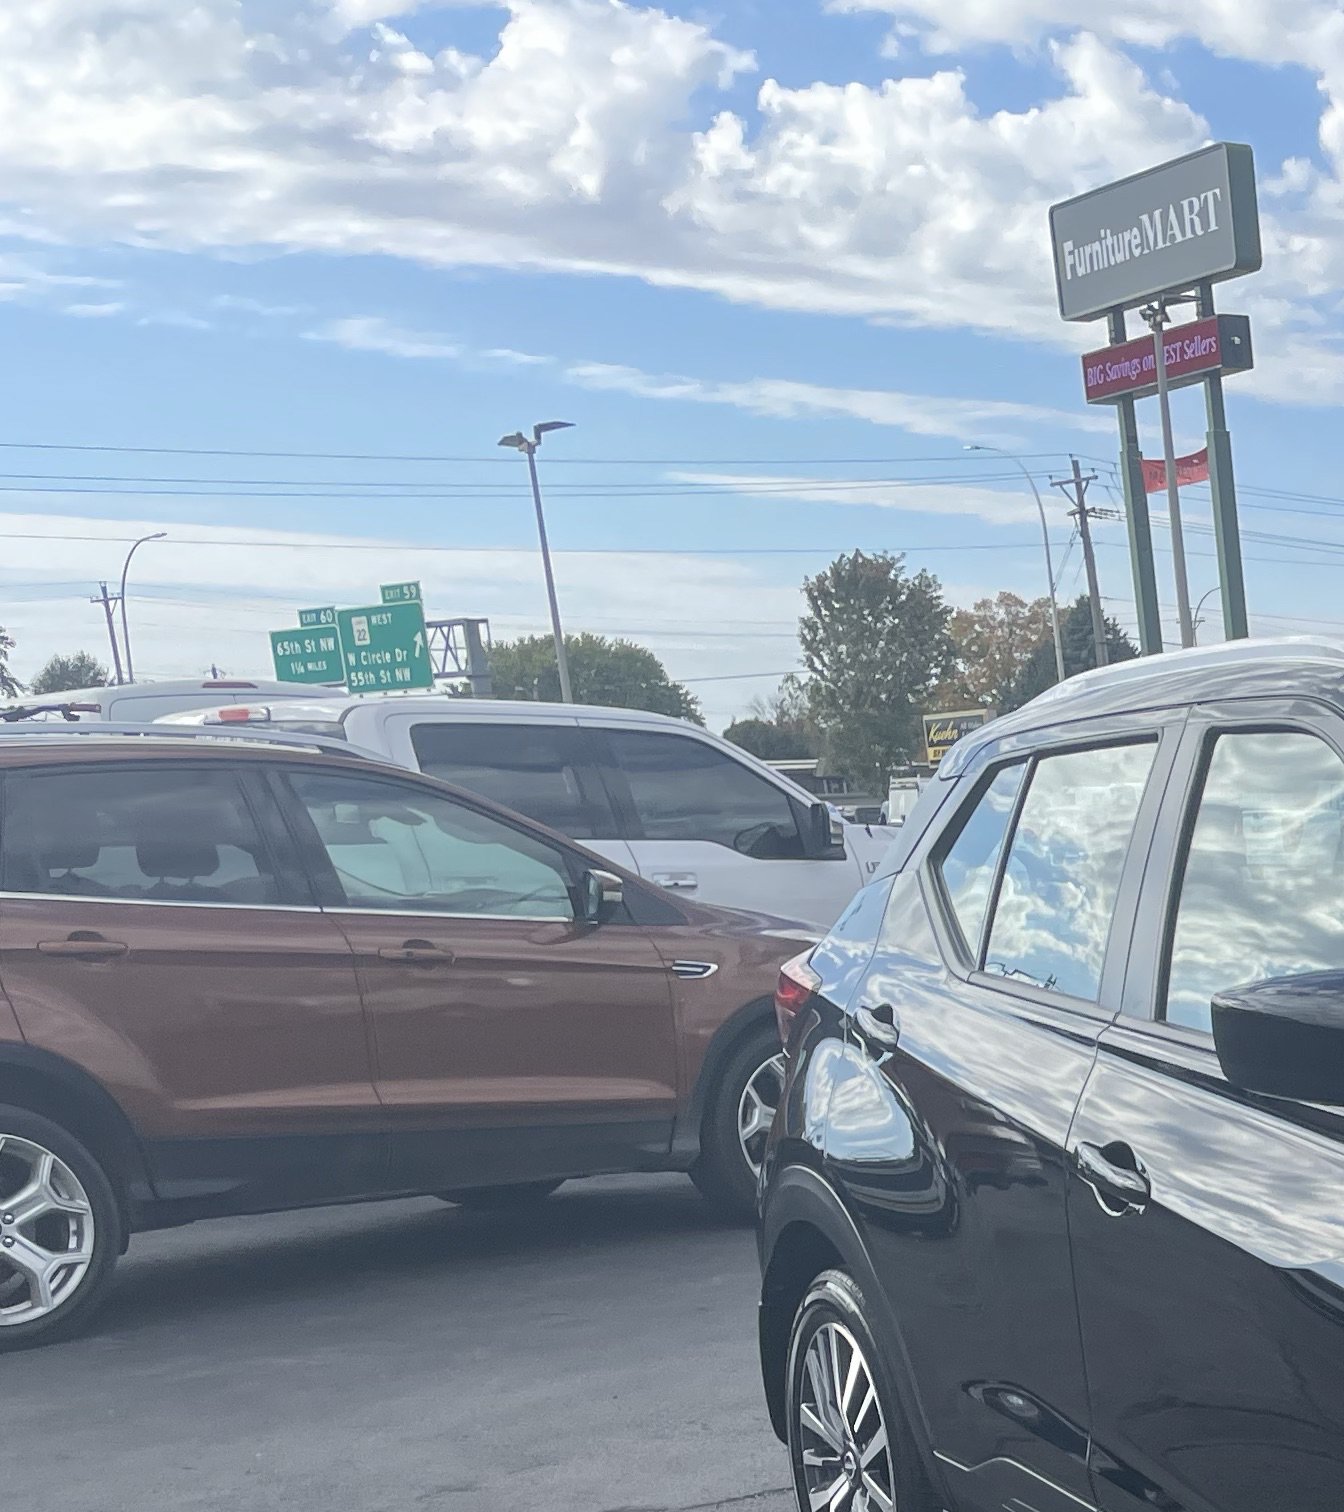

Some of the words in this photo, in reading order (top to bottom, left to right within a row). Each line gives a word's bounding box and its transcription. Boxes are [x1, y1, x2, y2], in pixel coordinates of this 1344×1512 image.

[1063, 188, 1221, 280] FurnitureMART
[1087, 364, 1104, 387] BIG
[1106, 357, 1141, 381] Savings
[1163, 341, 1182, 366] EST
[1184, 335, 1217, 360] Sellers
[403, 585, 417, 599] 59
[320, 609, 333, 624] 60
[371, 613, 392, 625] WEST
[357, 628, 367, 642] 22
[277, 641, 301, 656] 65th
[305, 638, 316, 653] St
[320, 637, 335, 652] NW
[307, 660, 327, 671] MILES
[347, 652, 356, 667] W
[361, 650, 391, 665] Circle
[395, 648, 407, 662] Dr
[350, 671, 376, 687] 55th
[380, 669, 392, 684] St
[395, 667, 411, 682] NW
